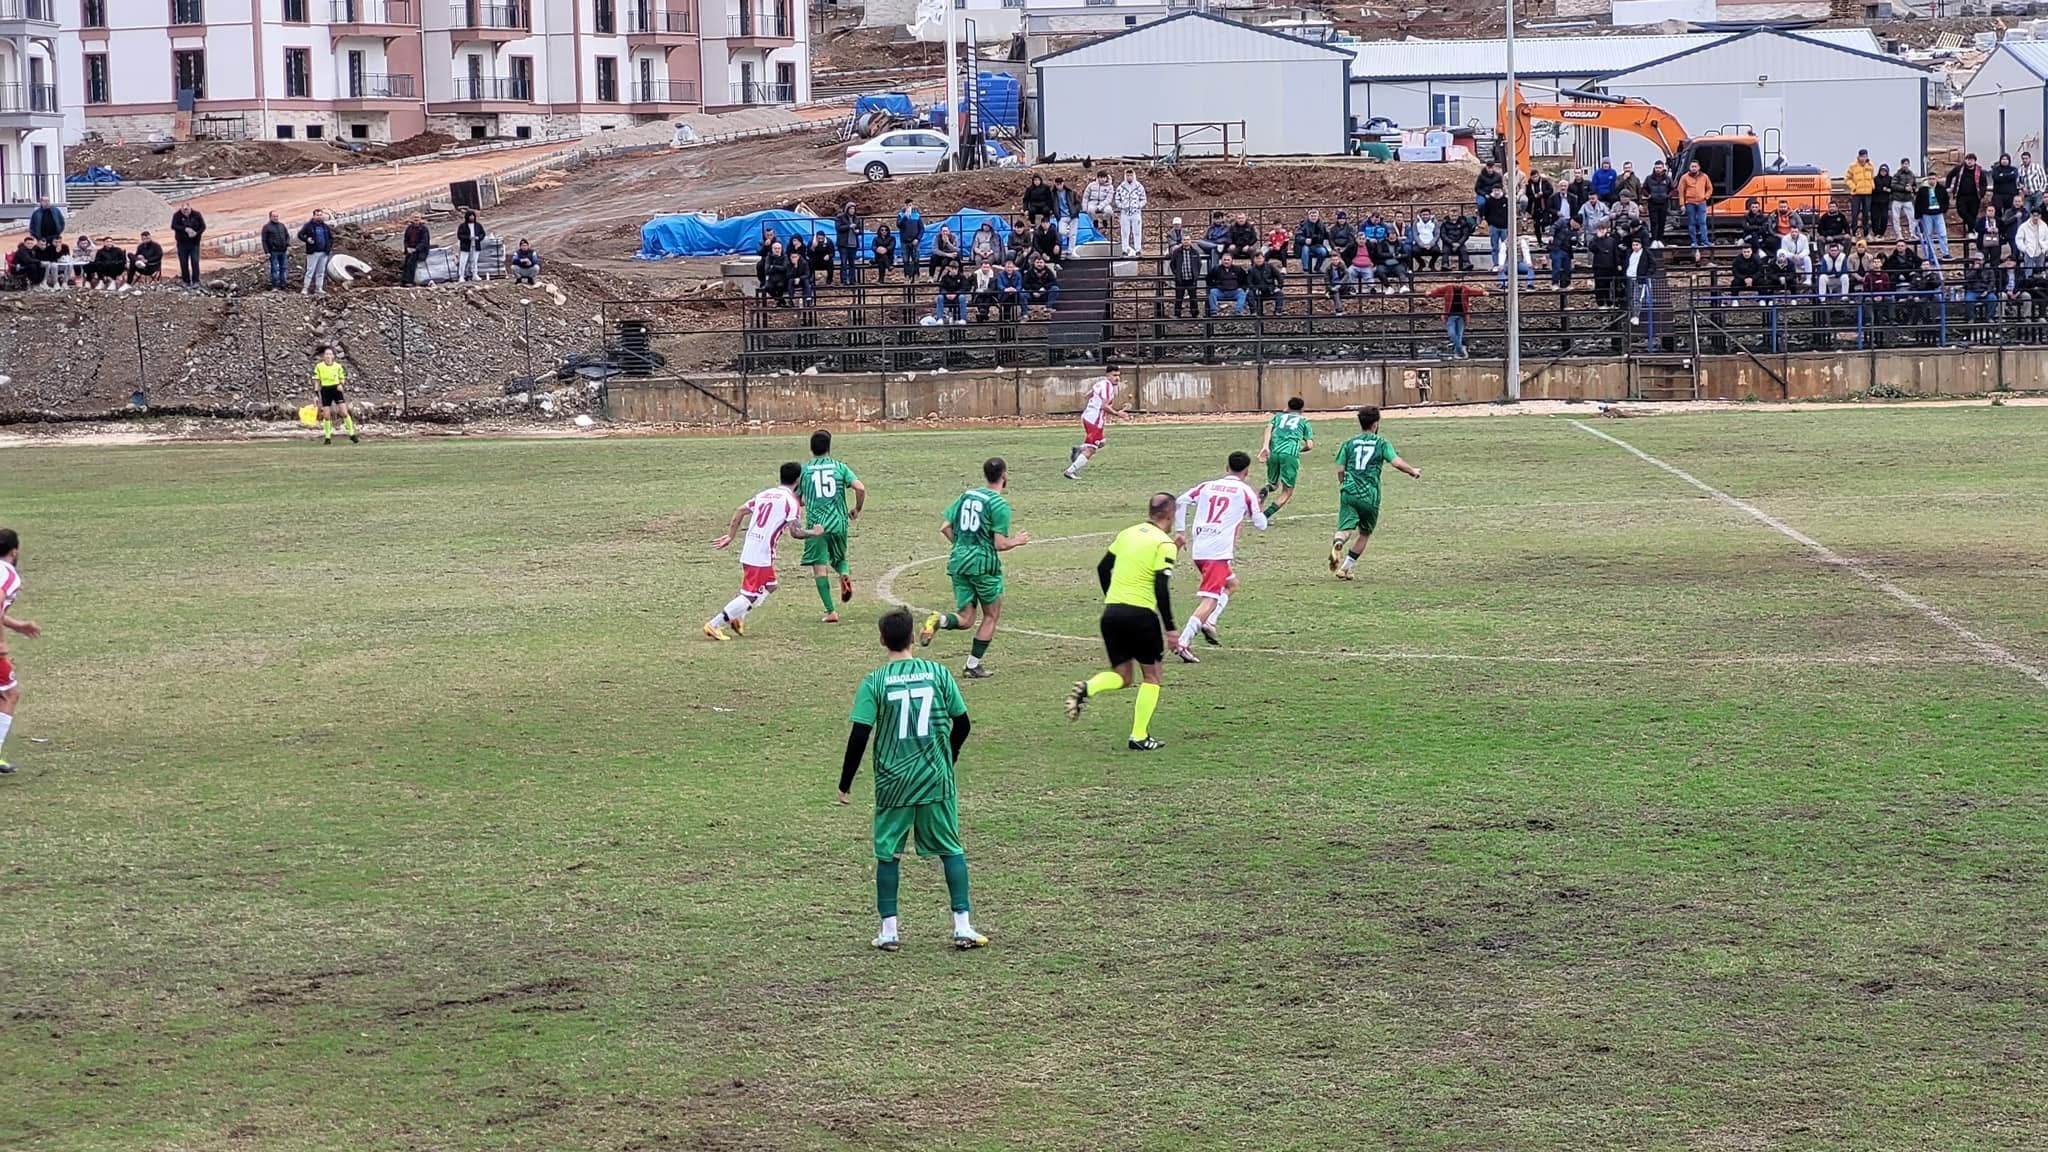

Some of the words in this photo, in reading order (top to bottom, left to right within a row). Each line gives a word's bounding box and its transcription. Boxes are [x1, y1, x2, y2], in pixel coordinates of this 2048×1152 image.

[1279, 414, 1300, 430] 14
[1354, 446, 1375, 470] 17
[811, 470, 836, 498] 15
[756, 502, 773, 528] 10
[960, 498, 983, 532] 66
[1206, 495, 1229, 523] 12
[887, 687, 934, 739] 77
